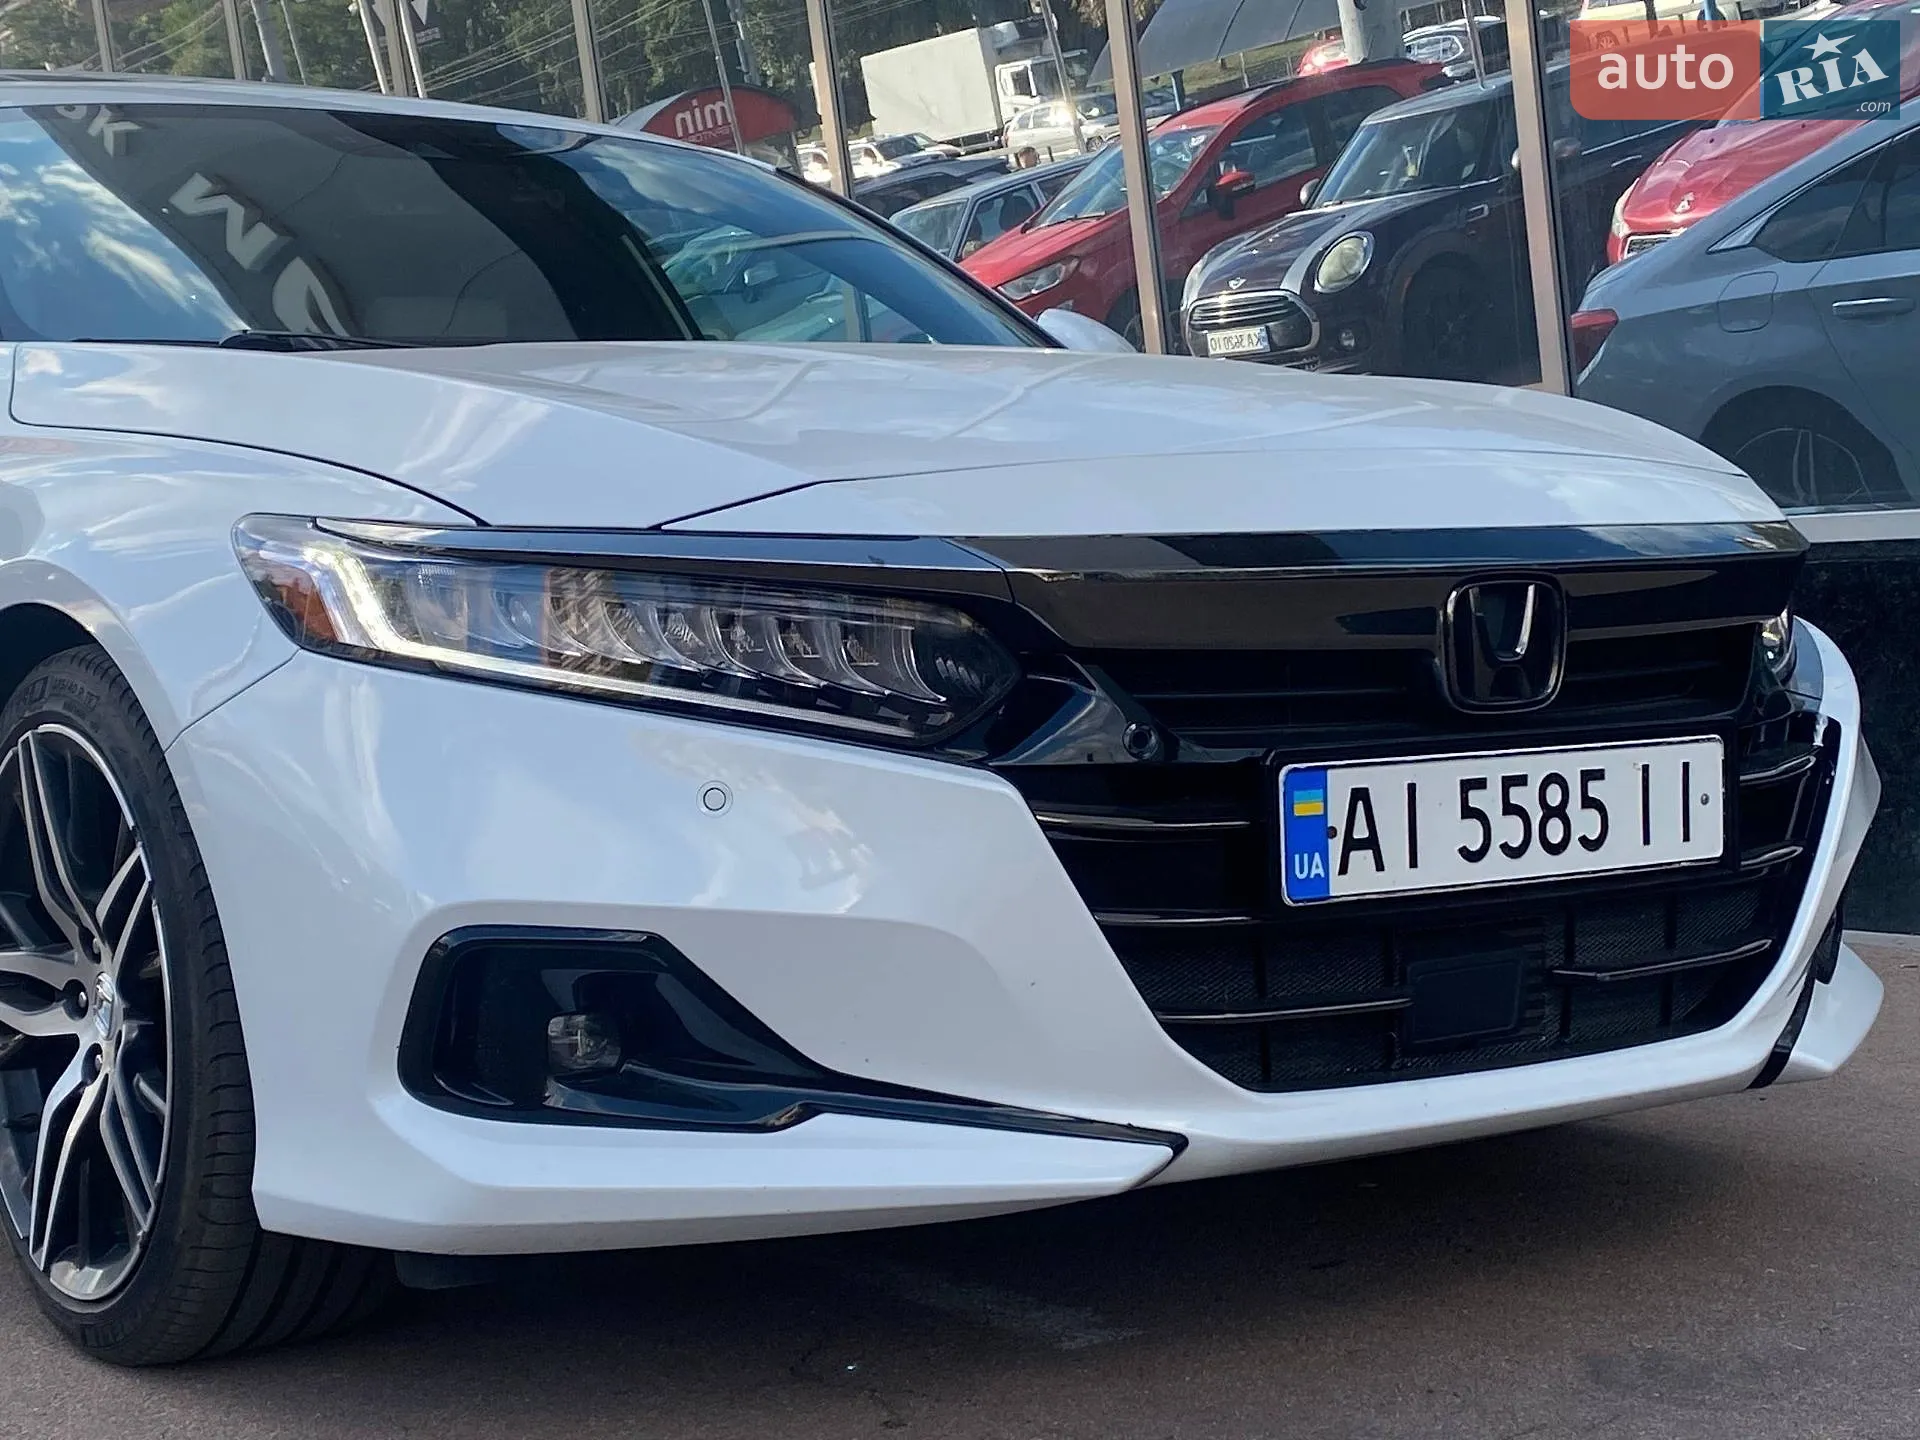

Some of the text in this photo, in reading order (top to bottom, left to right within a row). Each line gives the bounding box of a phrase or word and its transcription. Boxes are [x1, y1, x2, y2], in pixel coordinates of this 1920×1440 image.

[1337, 760, 1691, 876] AI 5585 II
[1294, 853, 1325, 880] UA
